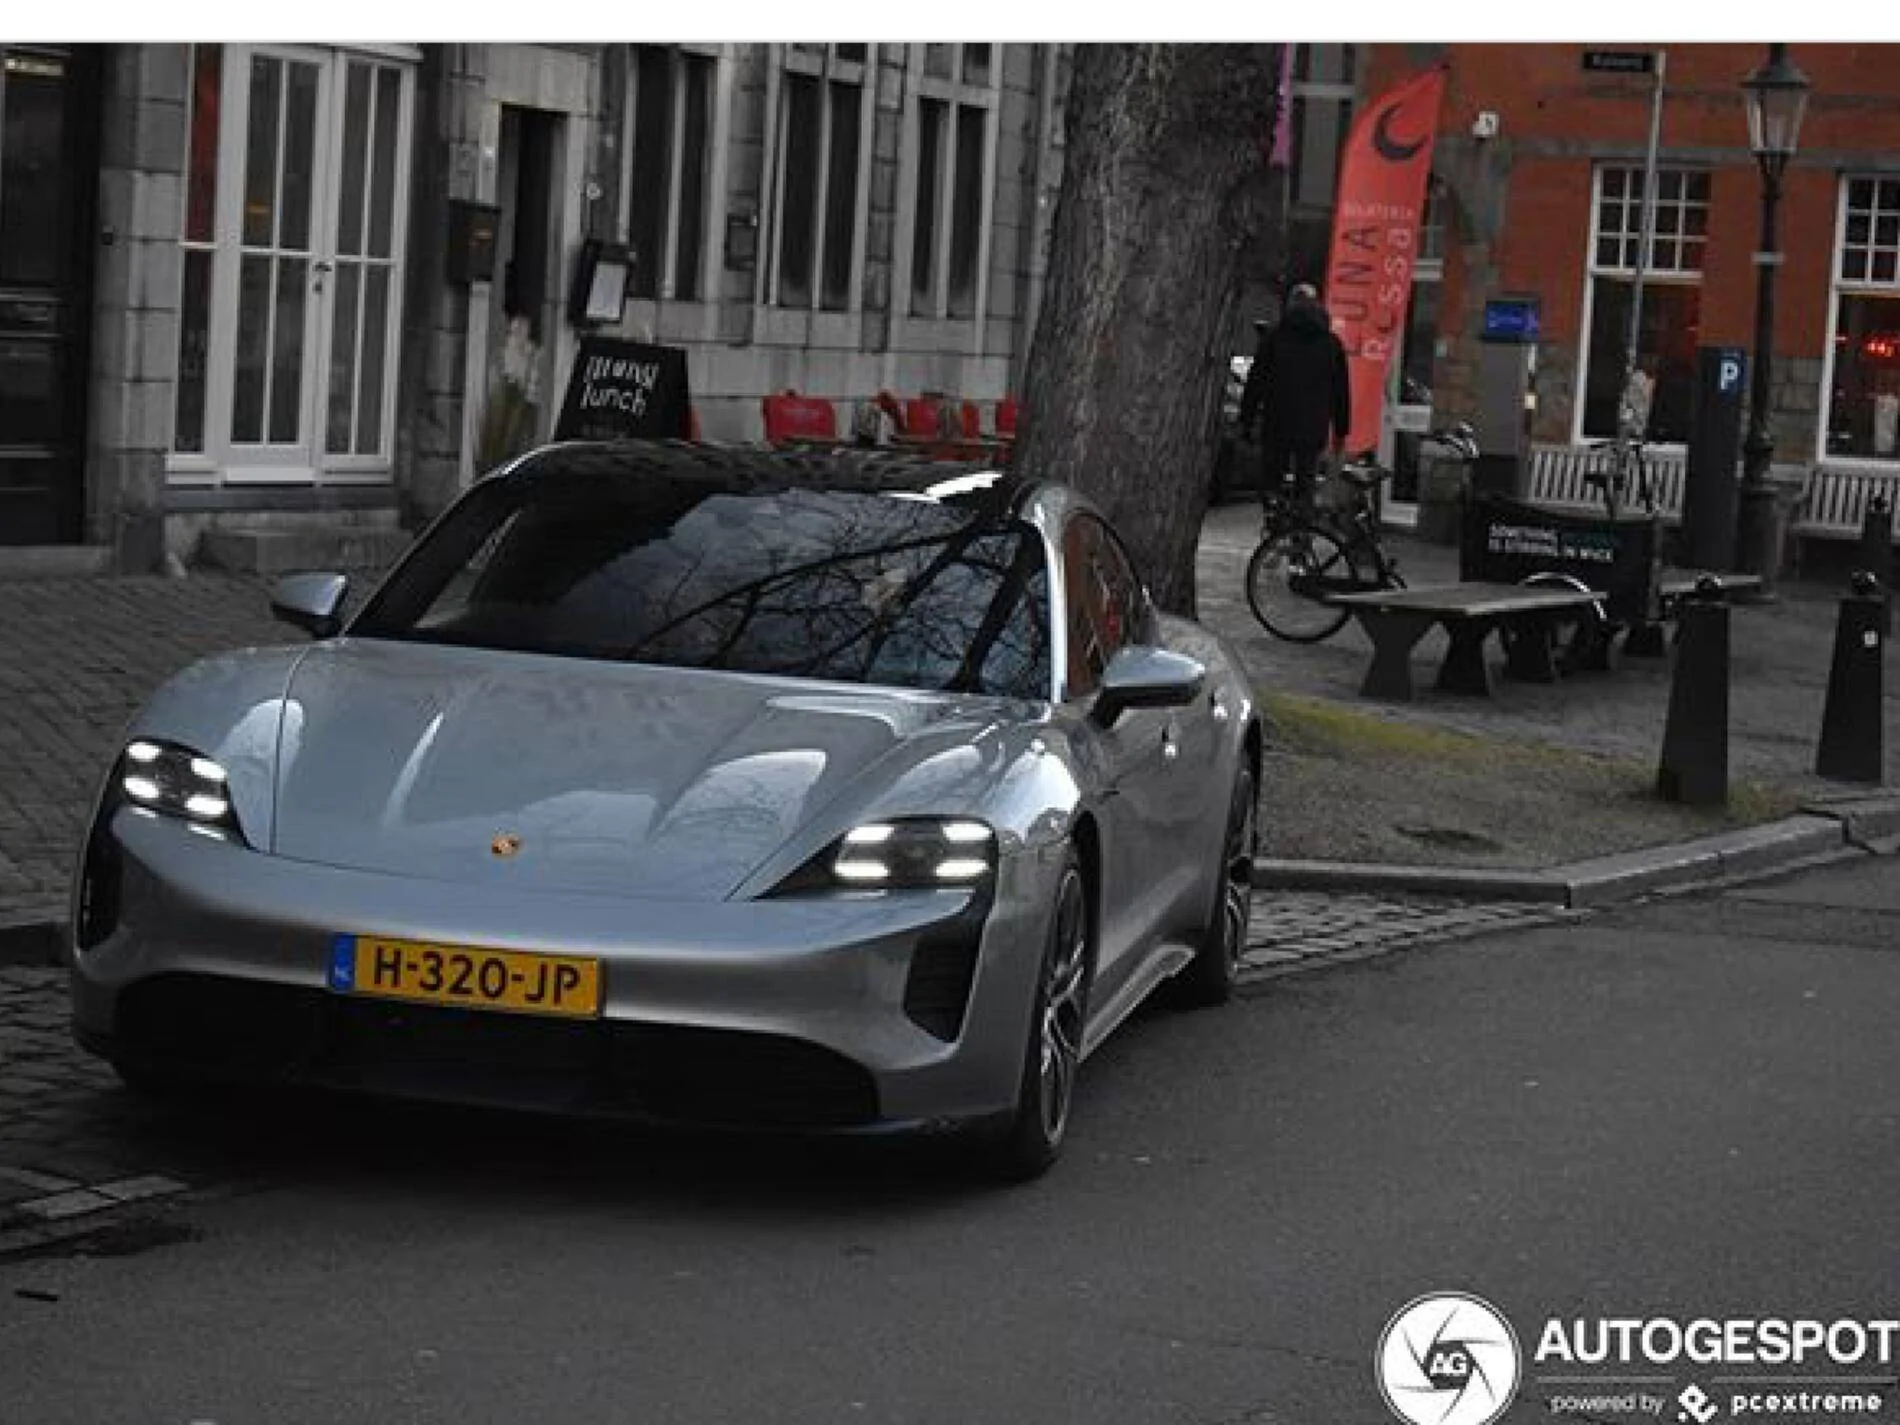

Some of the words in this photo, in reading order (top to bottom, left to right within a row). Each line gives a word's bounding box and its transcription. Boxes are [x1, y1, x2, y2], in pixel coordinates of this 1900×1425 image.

[1719, 360, 1739, 391] P
[580, 382, 649, 417] lunch
[373, 946, 581, 1005] H-320-JP
